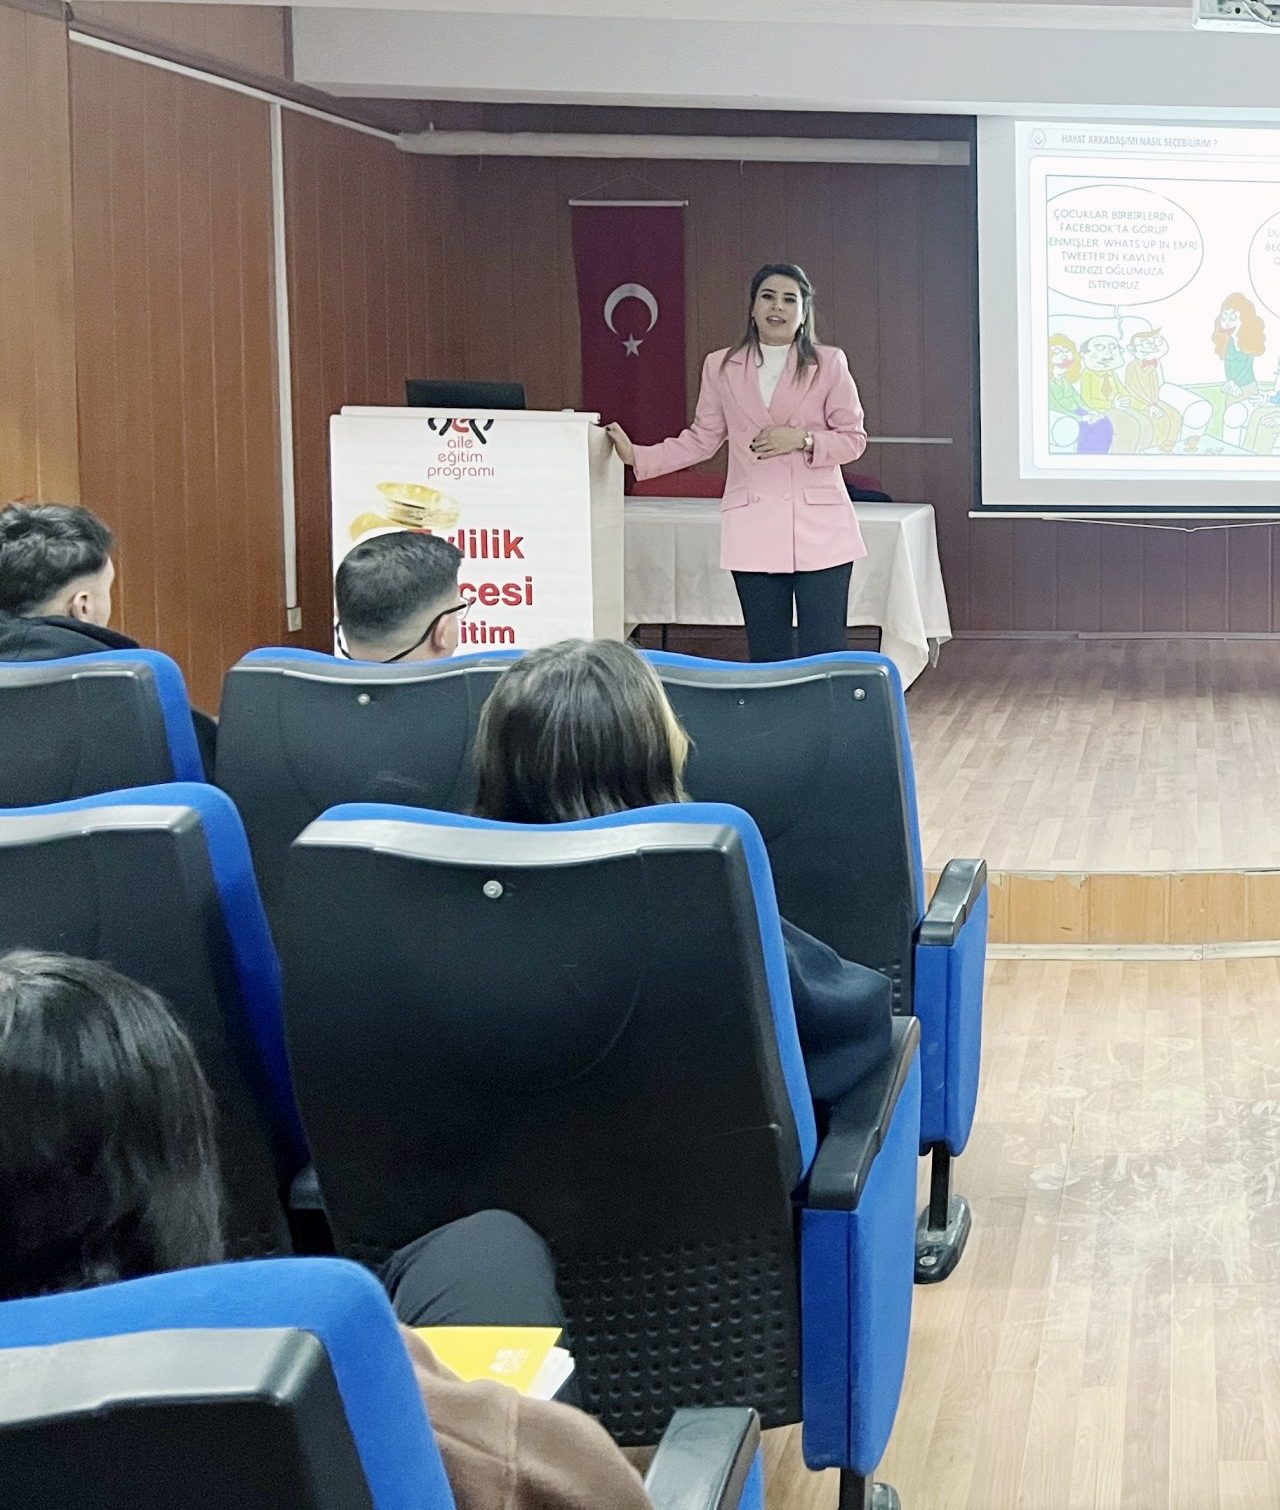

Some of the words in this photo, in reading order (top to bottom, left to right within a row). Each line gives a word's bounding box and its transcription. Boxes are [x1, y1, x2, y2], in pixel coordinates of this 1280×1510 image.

[1061, 134, 1086, 144] HAYAT
[1140, 136, 1162, 146] NASIL
[447, 436, 473, 449] aile
[438, 451, 483, 467] eğitim
[427, 465, 495, 480] programı
